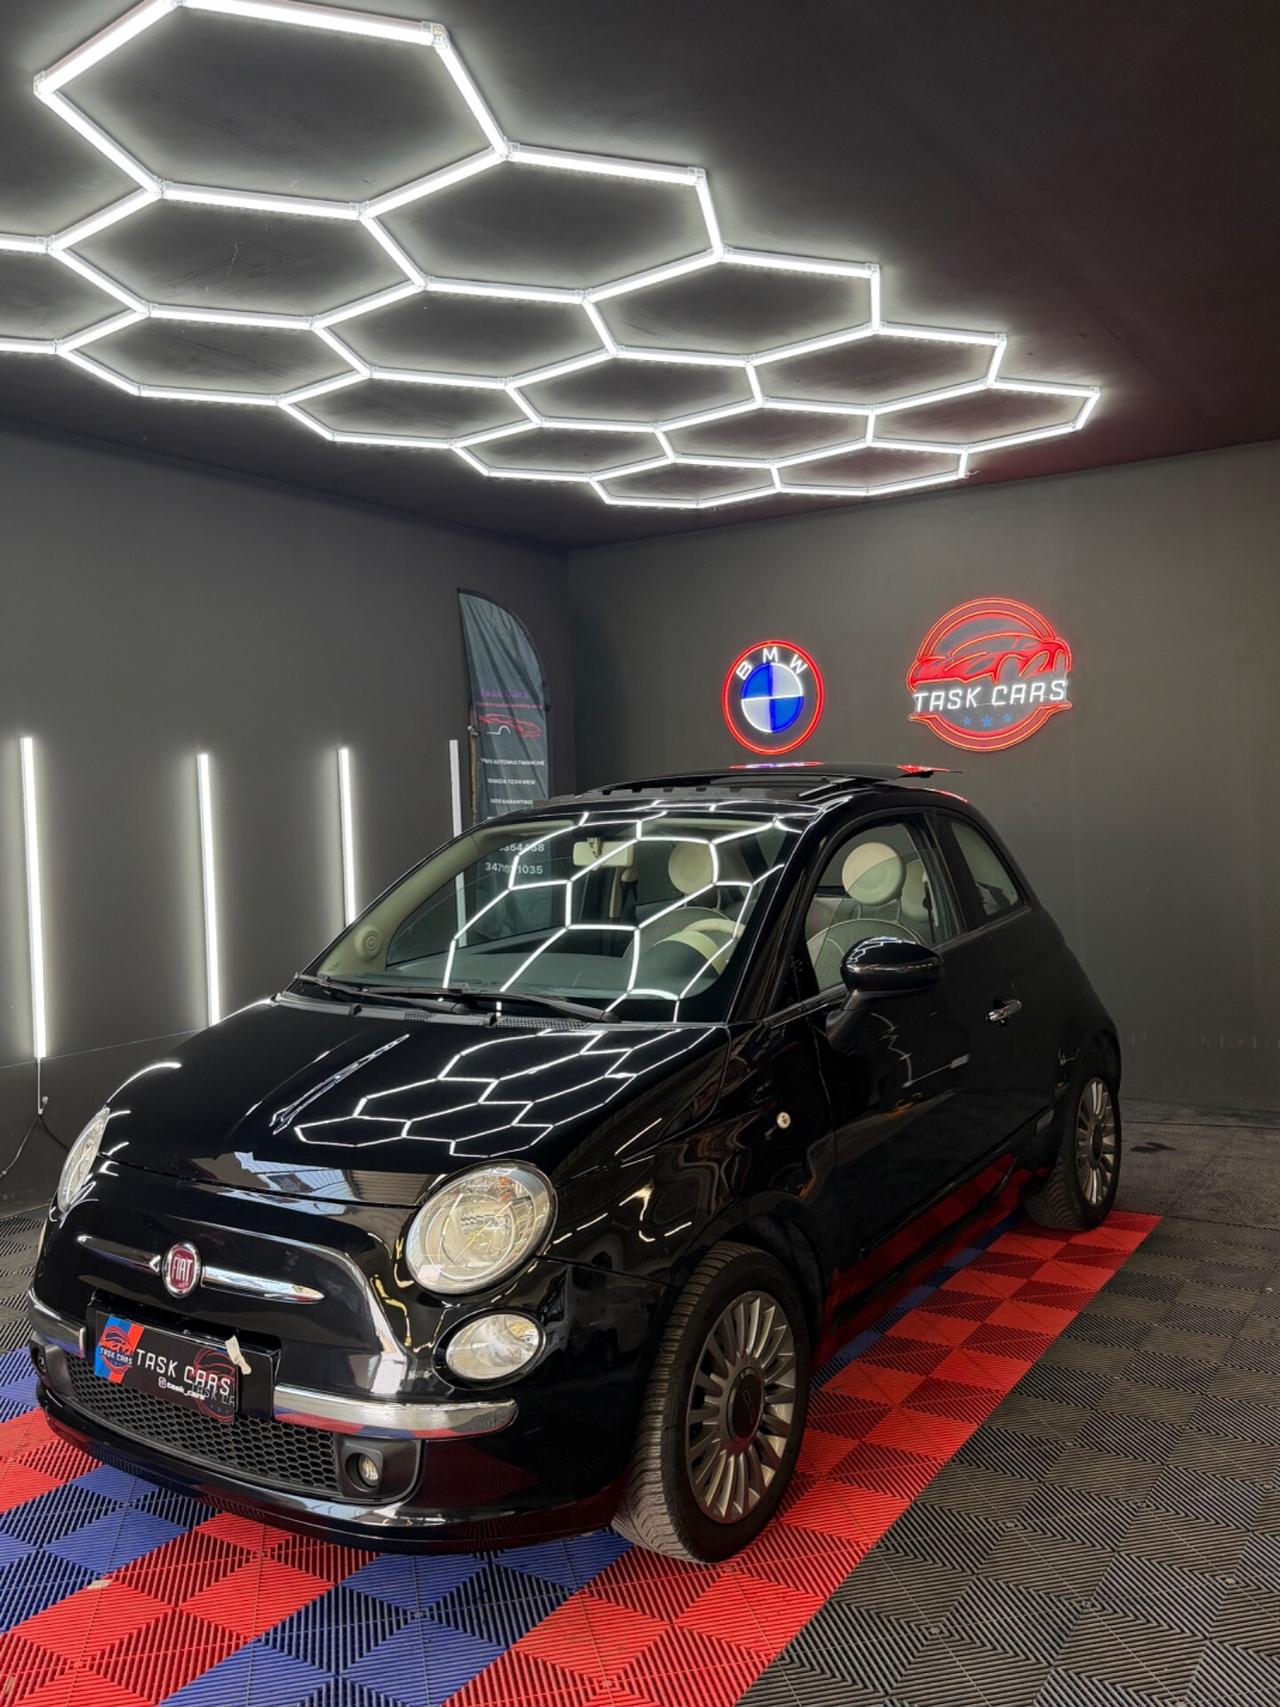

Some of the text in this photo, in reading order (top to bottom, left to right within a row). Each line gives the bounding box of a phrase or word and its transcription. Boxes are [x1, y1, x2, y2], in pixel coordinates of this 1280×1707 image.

[736, 646, 808, 681] BMW
[913, 680, 1066, 713] TASK CARS
[172, 1256, 193, 1284] FIAT
[136, 1348, 231, 1396] TASK CARS
